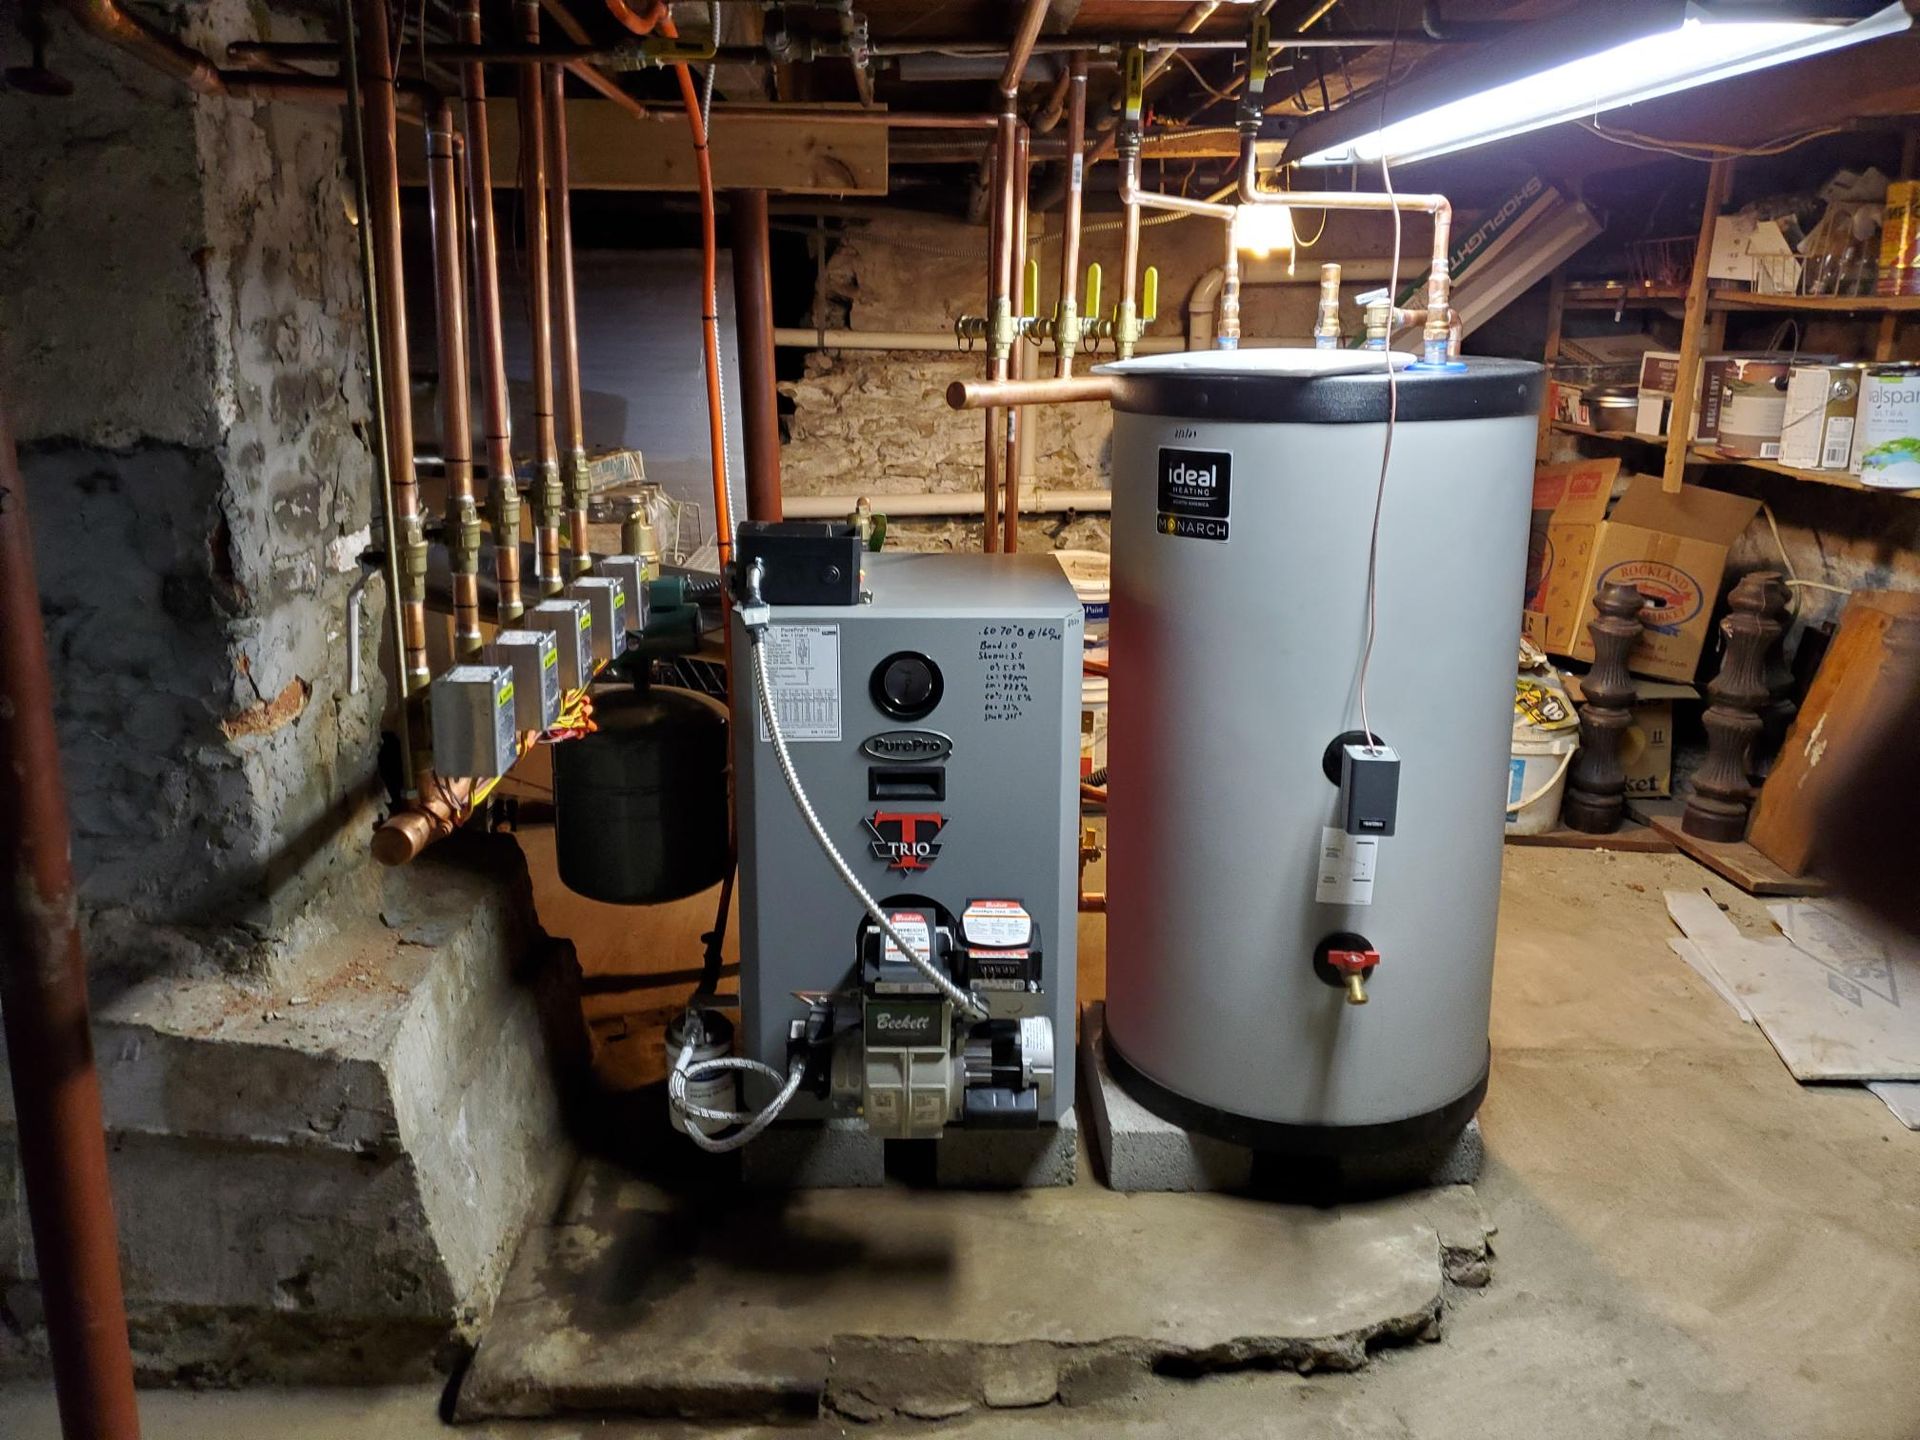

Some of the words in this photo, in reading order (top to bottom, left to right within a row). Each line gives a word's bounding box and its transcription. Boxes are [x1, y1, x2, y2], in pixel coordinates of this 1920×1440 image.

[1450, 176, 1542, 271] SHOPLIGHT
[1168, 462, 1217, 488] ideal
[1173, 487, 1210, 496] HEATING
[1158, 517, 1226, 537] MONARCH
[1620, 564, 1690, 590] ROCKLAND
[874, 738, 941, 753] PurePro
[887, 842, 930, 856] TRIO
[876, 1012, 930, 1030] Beckett
